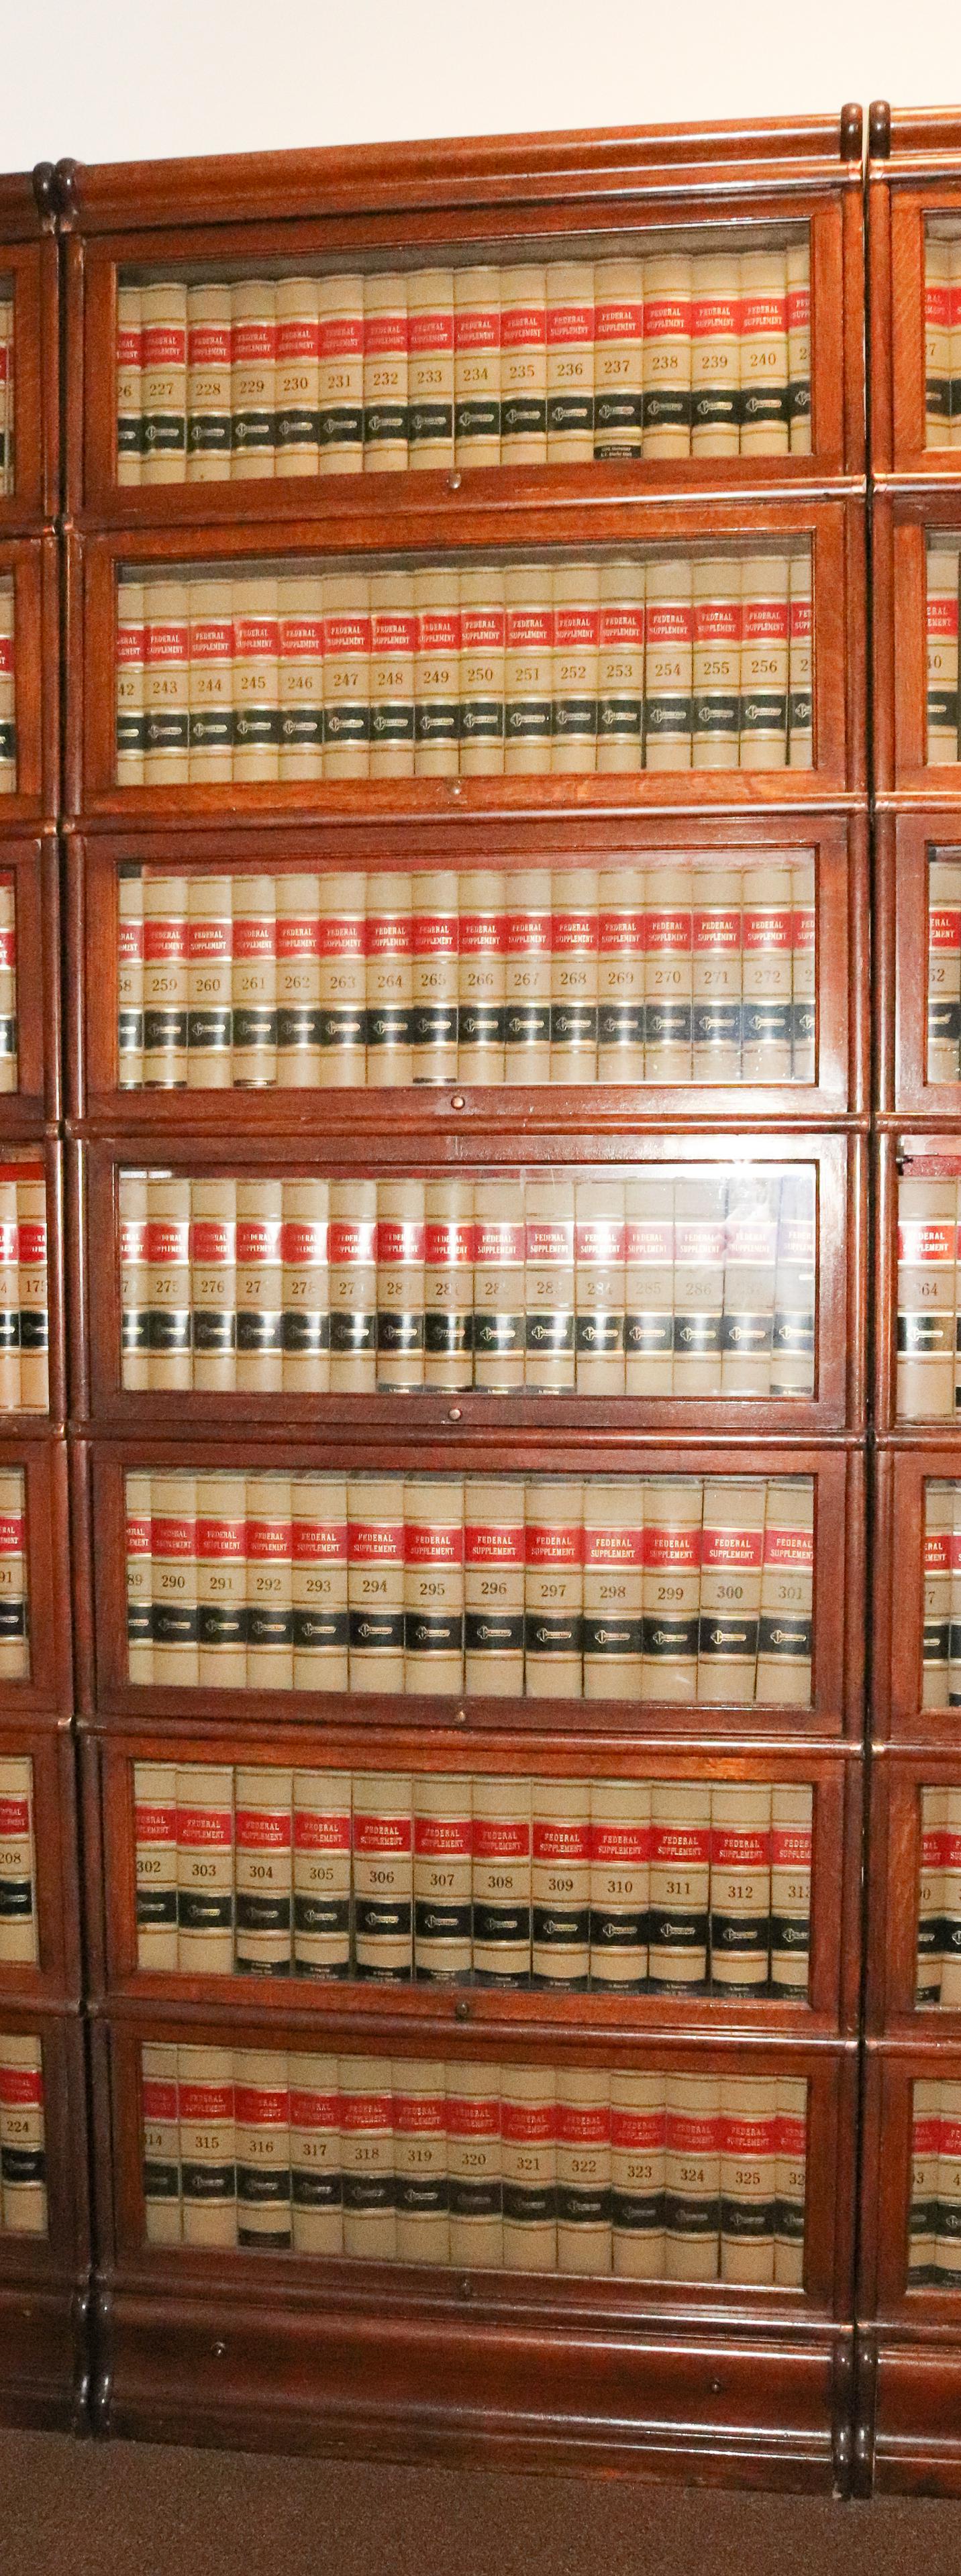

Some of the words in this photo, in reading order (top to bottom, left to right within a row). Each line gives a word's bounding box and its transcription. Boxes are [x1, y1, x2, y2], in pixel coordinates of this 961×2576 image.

[700, 307, 730, 317] FEDERAL
[748, 305, 778, 315] FEDERAL
[555, 315, 585, 325] FEDERAL
[602, 313, 631, 322] FEDERAL
[697, 318, 734, 327] SUPPLEMENT
[744, 315, 782, 325] SUPPLEMENT
[551, 325, 588, 335] SUPPLEMENT
[599, 323, 636, 332] SUPPLEMENT
[652, 356, 678, 369] 238
[702, 356, 727, 368] 239
[751, 353, 776, 366] 240
[510, 364, 535, 378] 235
[557, 363, 583, 376] 236
[605, 360, 630, 373] 237
[374, 372, 398, 385] 232
[417, 370, 442, 382] 233
[464, 368, 488, 381] 234
[241, 381, 264, 393] 229
[283, 378, 308, 390] 230
[328, 376, 351, 388] 231
[150, 383, 173, 396] 227
[196, 383, 221, 395] 228
[605, 616, 636, 625] FEDERAL
[654, 615, 684, 625] FEDERAL
[750, 611, 780, 621] FEDERAL
[465, 621, 495, 630] FEDERAL
[513, 619, 543, 629] FEDERAL
[650, 625, 687, 635] SUPPLEMENT
[746, 622, 784, 631] SUPPLEMENT
[196, 632, 224, 641] FEDERAL
[331, 626, 360, 635] FEDERAL
[462, 631, 499, 641] SUPPLEMENT
[510, 630, 546, 639] SUPPLEMENT
[603, 627, 639, 637] SUPPLEMENT
[193, 642, 228, 651] SUPPLEMENT
[327, 637, 364, 646] SUPPLEMENT
[561, 666, 586, 679] 252
[607, 665, 632, 677] 253
[656, 664, 680, 676] 254
[704, 662, 729, 675] 255
[751, 660, 777, 673] 256
[334, 674, 358, 686] 247
[378, 673, 403, 686] 248
[424, 671, 449, 684] 249
[468, 669, 493, 682] 250
[515, 668, 538, 681] 251
[153, 681, 177, 694] 243
[199, 679, 221, 692] 244
[242, 677, 265, 689] 245
[288, 677, 312, 689] 246
[652, 922, 683, 931] FEDERAL
[702, 922, 733, 930] FEDERAL
[752, 921, 783, 930] FEDERAL
[649, 932, 687, 942] SUPPLEMENT
[698, 932, 736, 941] SUPPLEMENT
[748, 932, 786, 941] SUPPLEMENT
[243, 977, 264, 989] 261
[285, 977, 309, 989] 262
[330, 977, 355, 989] 263
[378, 975, 402, 988] 264
[421, 973, 446, 986] 265
[468, 973, 493, 986] 266
[514, 973, 538, 985] 267
[560, 972, 586, 985] 268
[609, 972, 634, 984] 269
[655, 971, 680, 983] 270
[705, 971, 728, 983] 271
[755, 971, 780, 983] 272
[152, 979, 177, 991] 259
[197, 979, 219, 991] 260
[633, 1234, 663, 1242] FEDERAL
[629, 1244, 666, 1254] SUPPLEMENT
[202, 1281, 224, 1293] 276
[686, 1283, 711, 1295] 286
[302, 1534, 336, 1542] FEDERAL
[358, 1534, 393, 1542] FEDERAL
[415, 1536, 450, 1544] FEDERAL
[478, 1536, 512, 1544] FEDERAL
[596, 1539, 631, 1547] FEDERAL
[654, 1540, 689, 1548] FEDERAL
[715, 1539, 750, 1548] FEDERAL
[297, 1544, 340, 1552] SUPPLEMENT
[354, 1544, 396, 1553] SUPPLEMENT
[410, 1547, 454, 1555] SUPPLEMENT
[473, 1546, 515, 1555] SUPPLEMENT
[532, 1547, 574, 1556] SUPPLEMENT
[591, 1550, 635, 1558] SUPPLEMENT
[650, 1550, 693, 1558] SUPPLEMENT
[709, 1550, 754, 1559] SUPPLEMENT
[162, 1576, 185, 1588] 290
[210, 1577, 233, 1590] 291
[257, 1578, 281, 1591] 292
[307, 1580, 331, 1592] 293
[363, 1580, 387, 1593] 294
[419, 1583, 445, 1596] 295
[481, 1582, 507, 1595] 296
[541, 1585, 566, 1597] 297
[600, 1586, 625, 1599] 298
[658, 1587, 683, 1600] 299
[717, 1587, 743, 1599] 300
[778, 1587, 802, 1599] 301
[187, 1819, 220, 1828] FEDERAL
[183, 1829, 223, 1839] SUPPLEMENT
[544, 1834, 579, 1843] FEDERAL
[603, 1836, 638, 1845] FEDERAL
[663, 1836, 697, 1845] FEDERAL
[725, 1840, 760, 1848] FEDERAL
[540, 1843, 583, 1853] SUPPLEMENT
[599, 1845, 641, 1854] SUPPLEMENT
[658, 1846, 701, 1856] SUPPLEMENT
[719, 1849, 763, 1858] SUPPLEMENT
[138, 1862, 160, 1873] 302
[193, 1865, 216, 1876] 303
[250, 1866, 272, 1878] 304
[310, 1868, 334, 1880] 305
[370, 1871, 394, 1884] 306
[431, 1874, 454, 1886] 307
[489, 1876, 513, 1888] 308
[549, 1879, 573, 1892] 309
[608, 1881, 633, 1893] 310
[666, 1882, 691, 1895] 311
[728, 1886, 753, 1898] 312
[7, 2121, 29, 2133] 224
[731, 2127, 766, 2135] FEDERAL
[195, 2137, 219, 2149] 315
[250, 2141, 273, 2153] 316
[727, 2137, 769, 2147] SUPPLEMENT
[303, 2145, 327, 2157] 317
[356, 2147, 379, 2160] 318
[408, 2150, 432, 2162] 319
[462, 2153, 486, 2165] 320
[517, 2157, 539, 2169] 321
[572, 2160, 596, 2173] 322
[628, 2165, 652, 2178] 323
[680, 2169, 704, 2182] 324
[736, 2171, 760, 2184] 325
